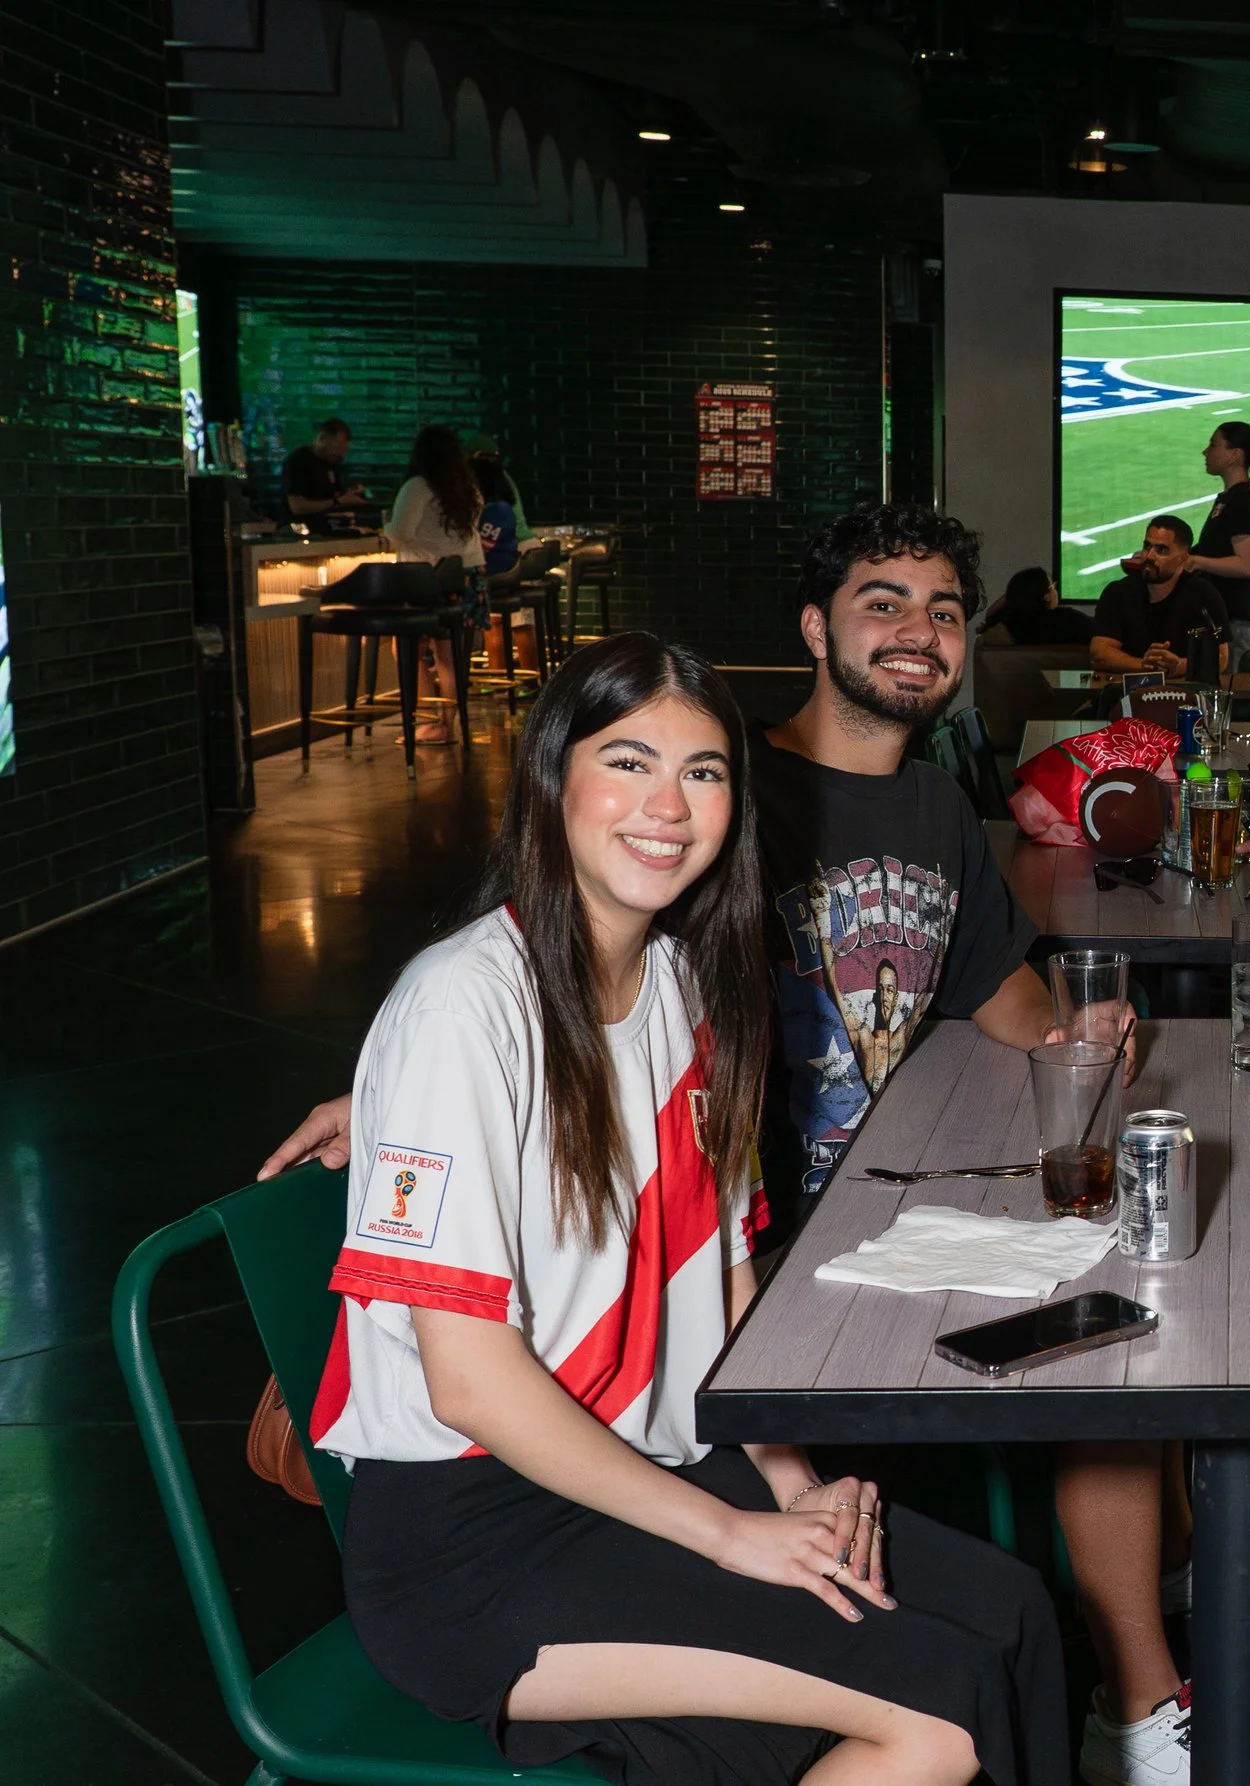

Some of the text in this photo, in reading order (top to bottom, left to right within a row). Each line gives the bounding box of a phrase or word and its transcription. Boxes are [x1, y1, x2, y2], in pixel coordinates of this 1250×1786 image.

[378, 1150, 445, 1171] QUALIFIERS
[368, 1222, 423, 1240] RUSSIA 2018
